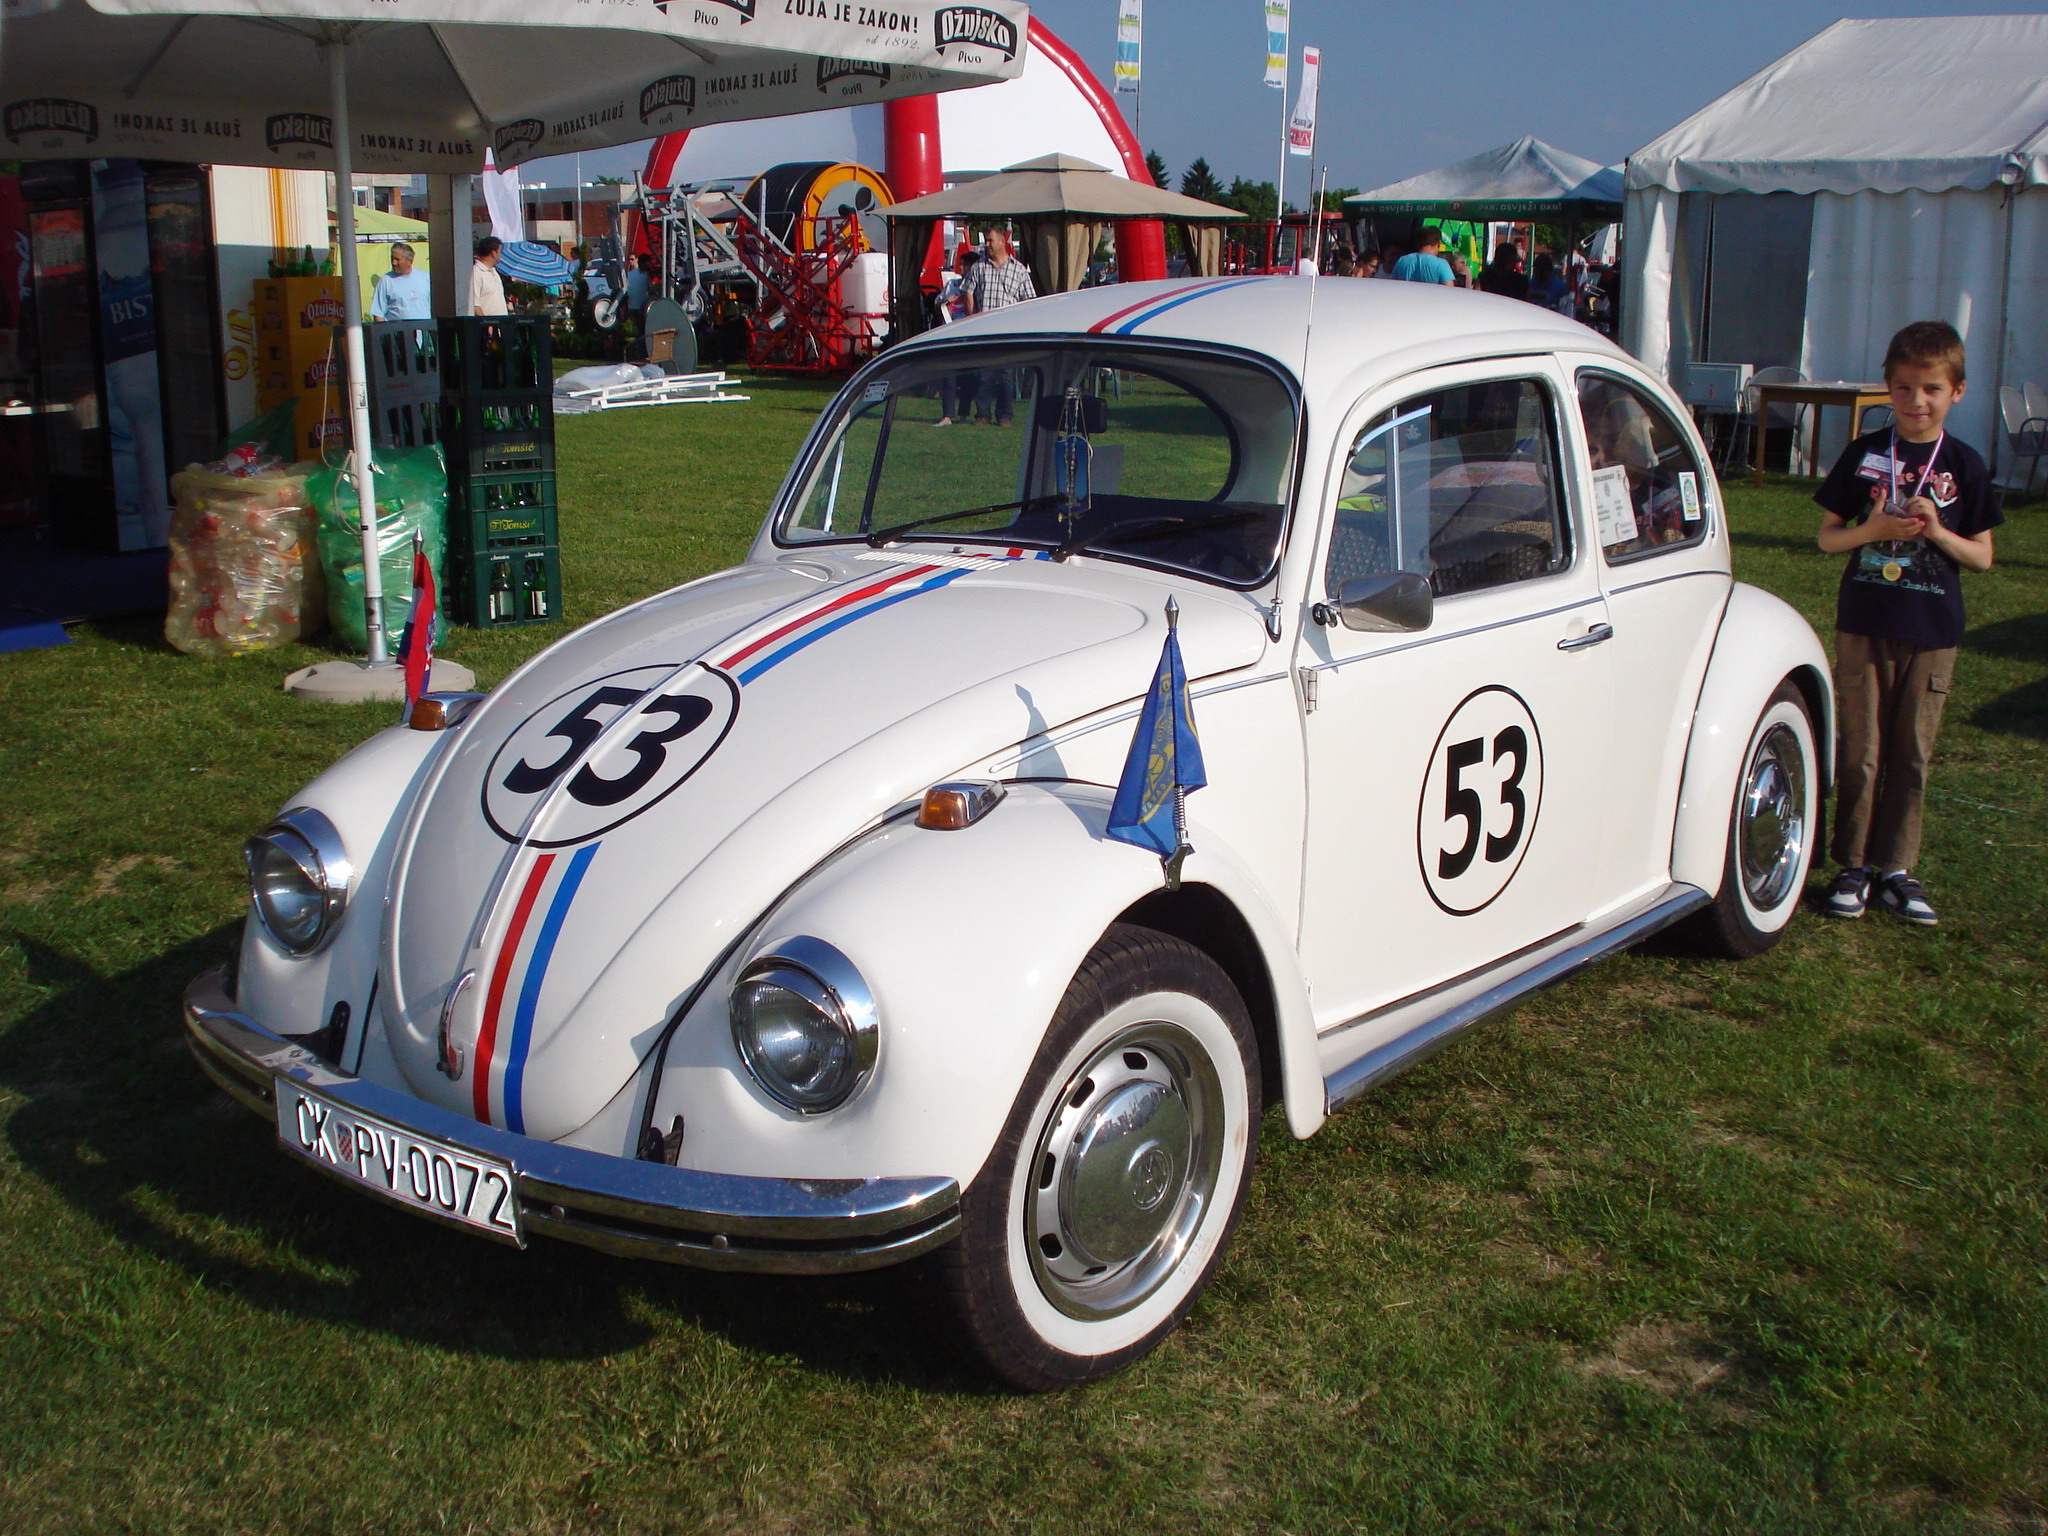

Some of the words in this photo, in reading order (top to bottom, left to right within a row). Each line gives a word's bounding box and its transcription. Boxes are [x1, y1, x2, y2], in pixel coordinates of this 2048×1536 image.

[694, 9, 719, 26] Pivo
[834, 4, 851, 22] JE
[858, 7, 918, 34] ZAKON!
[941, 10, 1010, 47] Ožujsko
[884, 36, 920, 50] 1892.
[958, 51, 982, 64] Pivo
[503, 686, 713, 806] 53
[1438, 725, 1527, 880] 53
[296, 1094, 337, 1164] ČK
[355, 1122, 516, 1231] PV-0072
